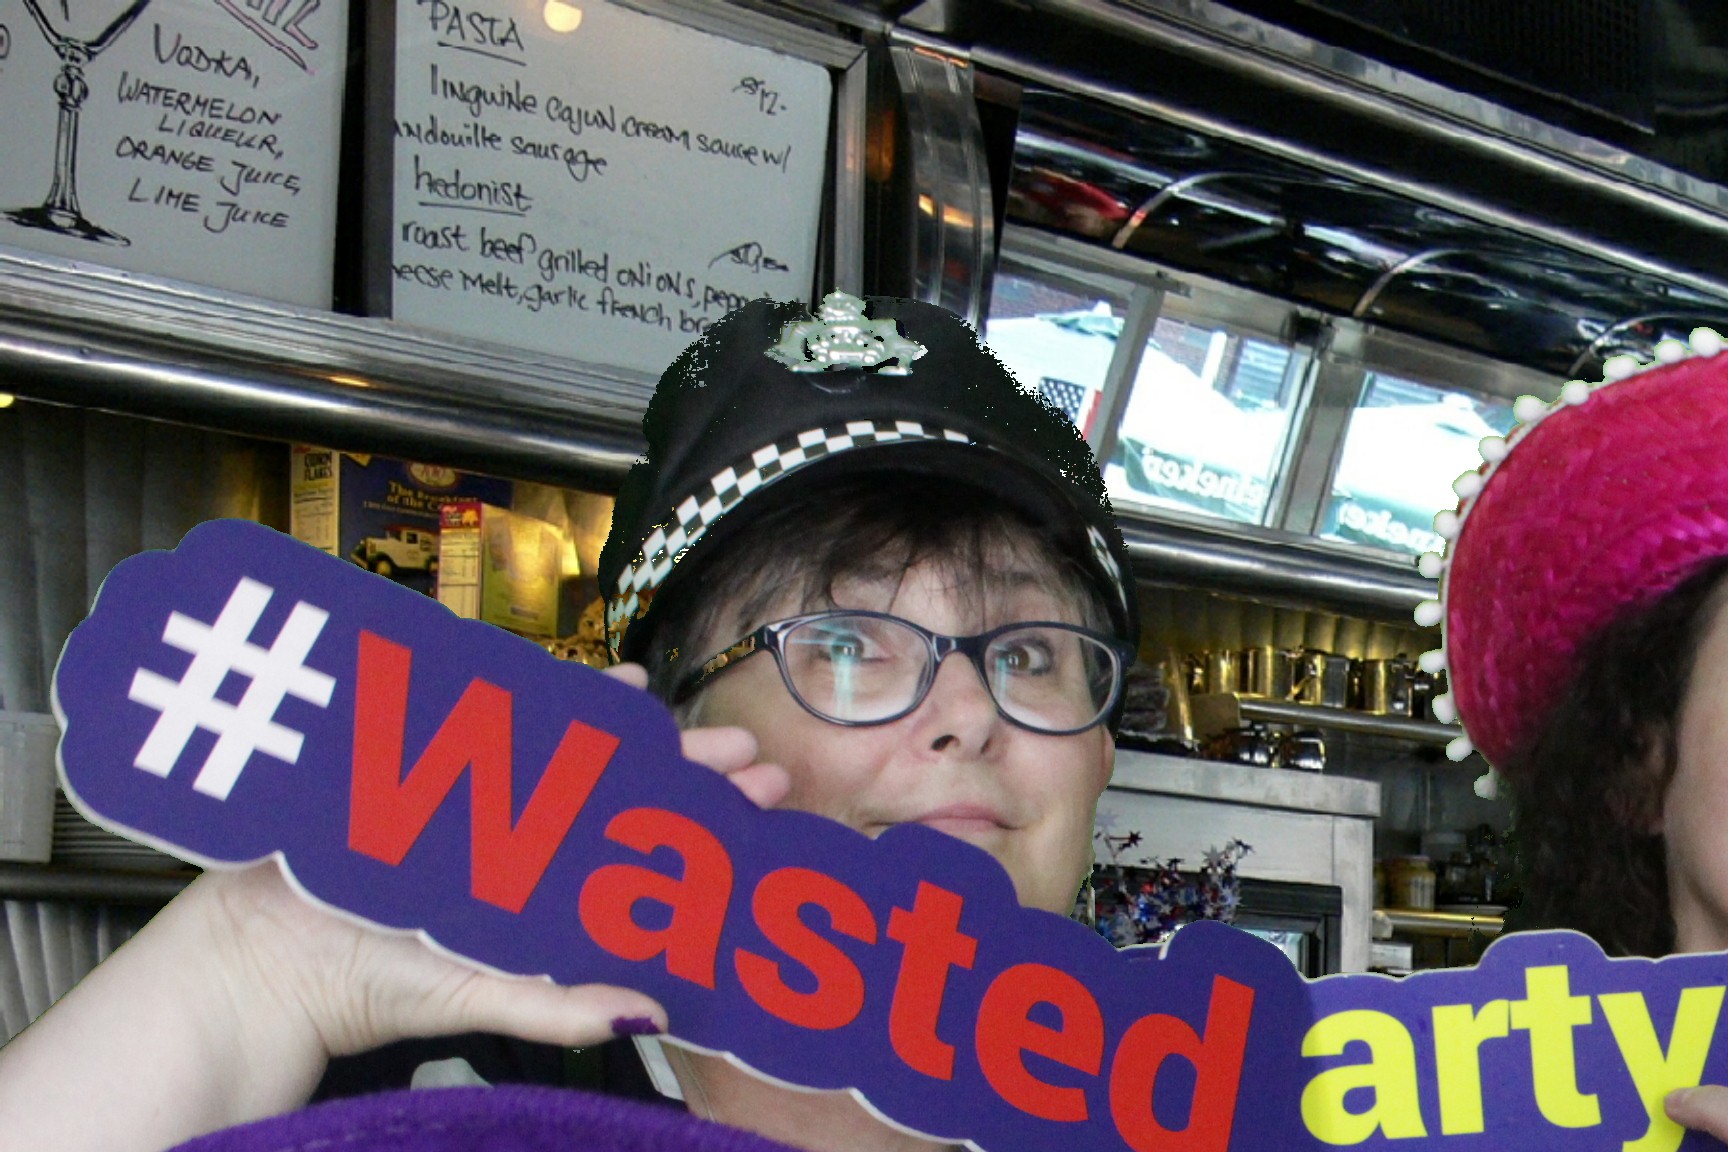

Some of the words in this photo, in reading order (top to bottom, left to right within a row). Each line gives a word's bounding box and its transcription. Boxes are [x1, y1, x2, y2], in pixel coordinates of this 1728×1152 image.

[416, 0, 525, 52] PASTA
[153, 22, 260, 89] VODKA,
[118, 70, 283, 126] WATERMELON
[116, 135, 215, 173] ORANGE
[158, 113, 284, 160] LIQUEUR,
[128, 177, 201, 213] LIME
[203, 201, 290, 234] JUICE
[414, 154, 535, 212] hedonist
[402, 220, 470, 253] roast
[480, 226, 537, 265] beef
[538, 248, 609, 283] grilled
[522, 283, 589, 312] garlic
